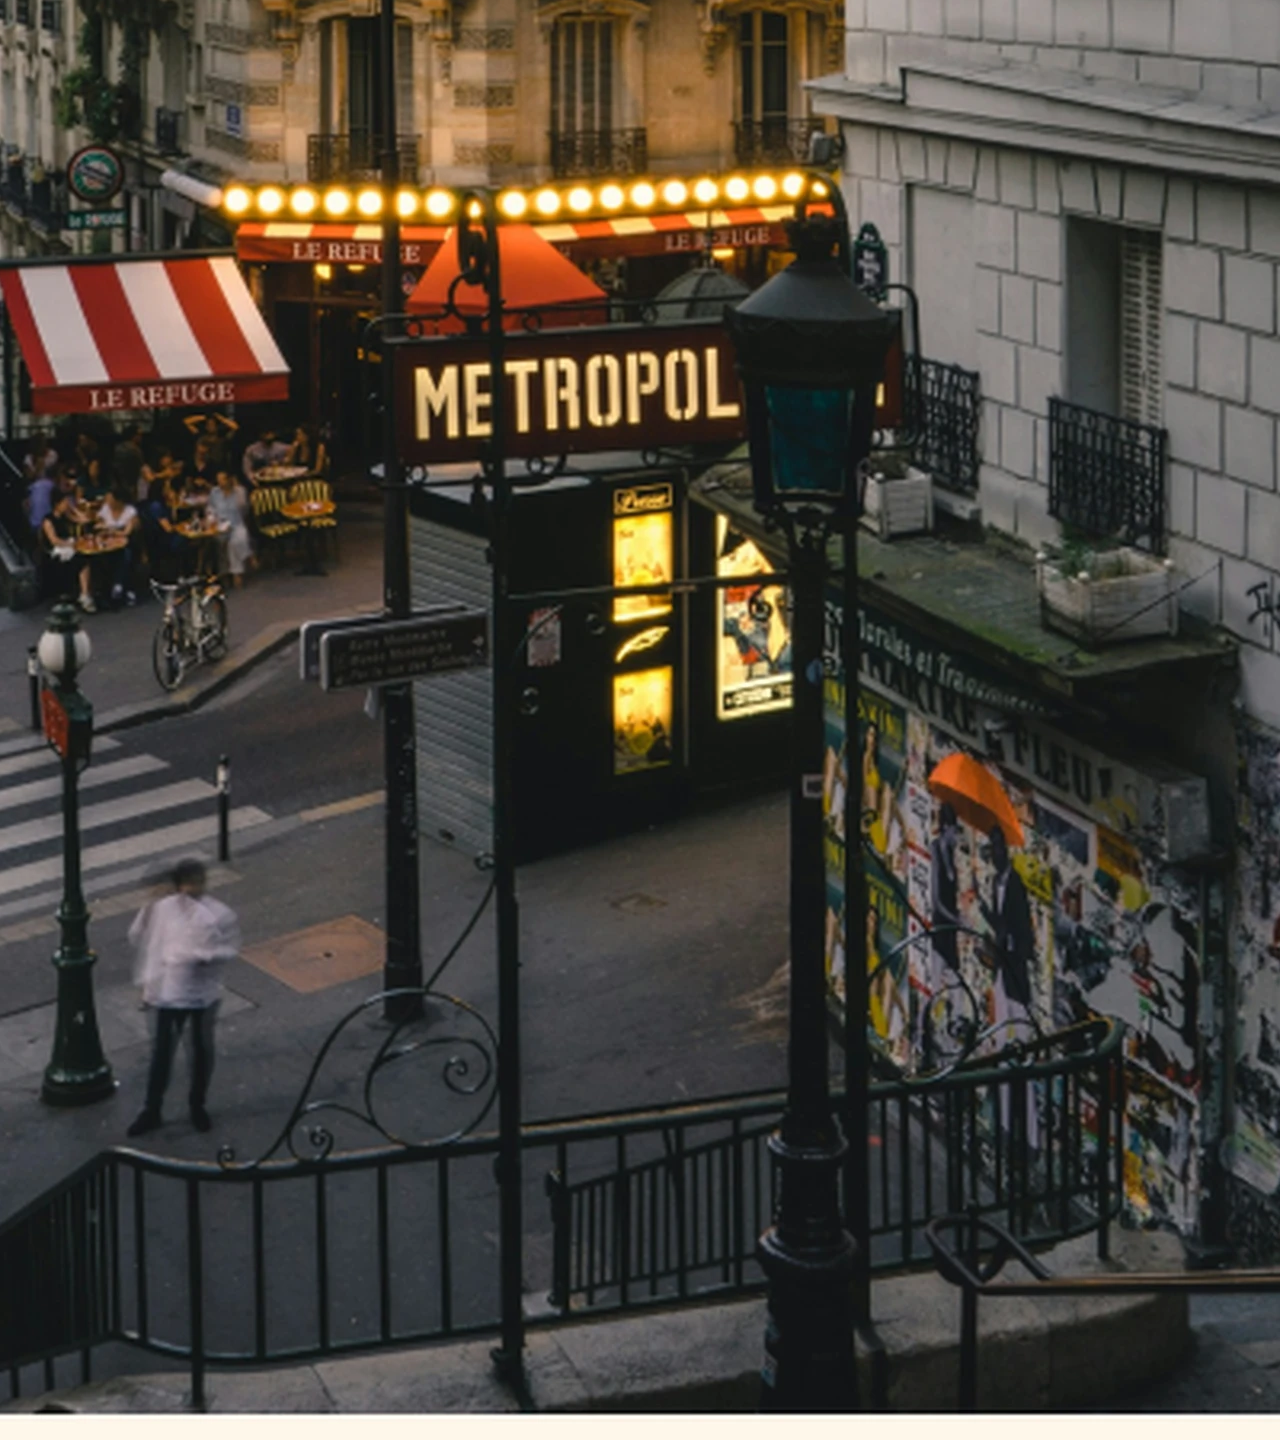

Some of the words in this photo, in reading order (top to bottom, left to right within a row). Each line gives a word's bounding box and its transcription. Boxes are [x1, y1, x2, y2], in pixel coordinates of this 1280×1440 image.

[293, 241, 321, 260] LE
[328, 242, 420, 264] REFUE
[666, 234, 690, 252] LE
[90, 389, 123, 410] LE
[130, 381, 236, 407] REFUGE
